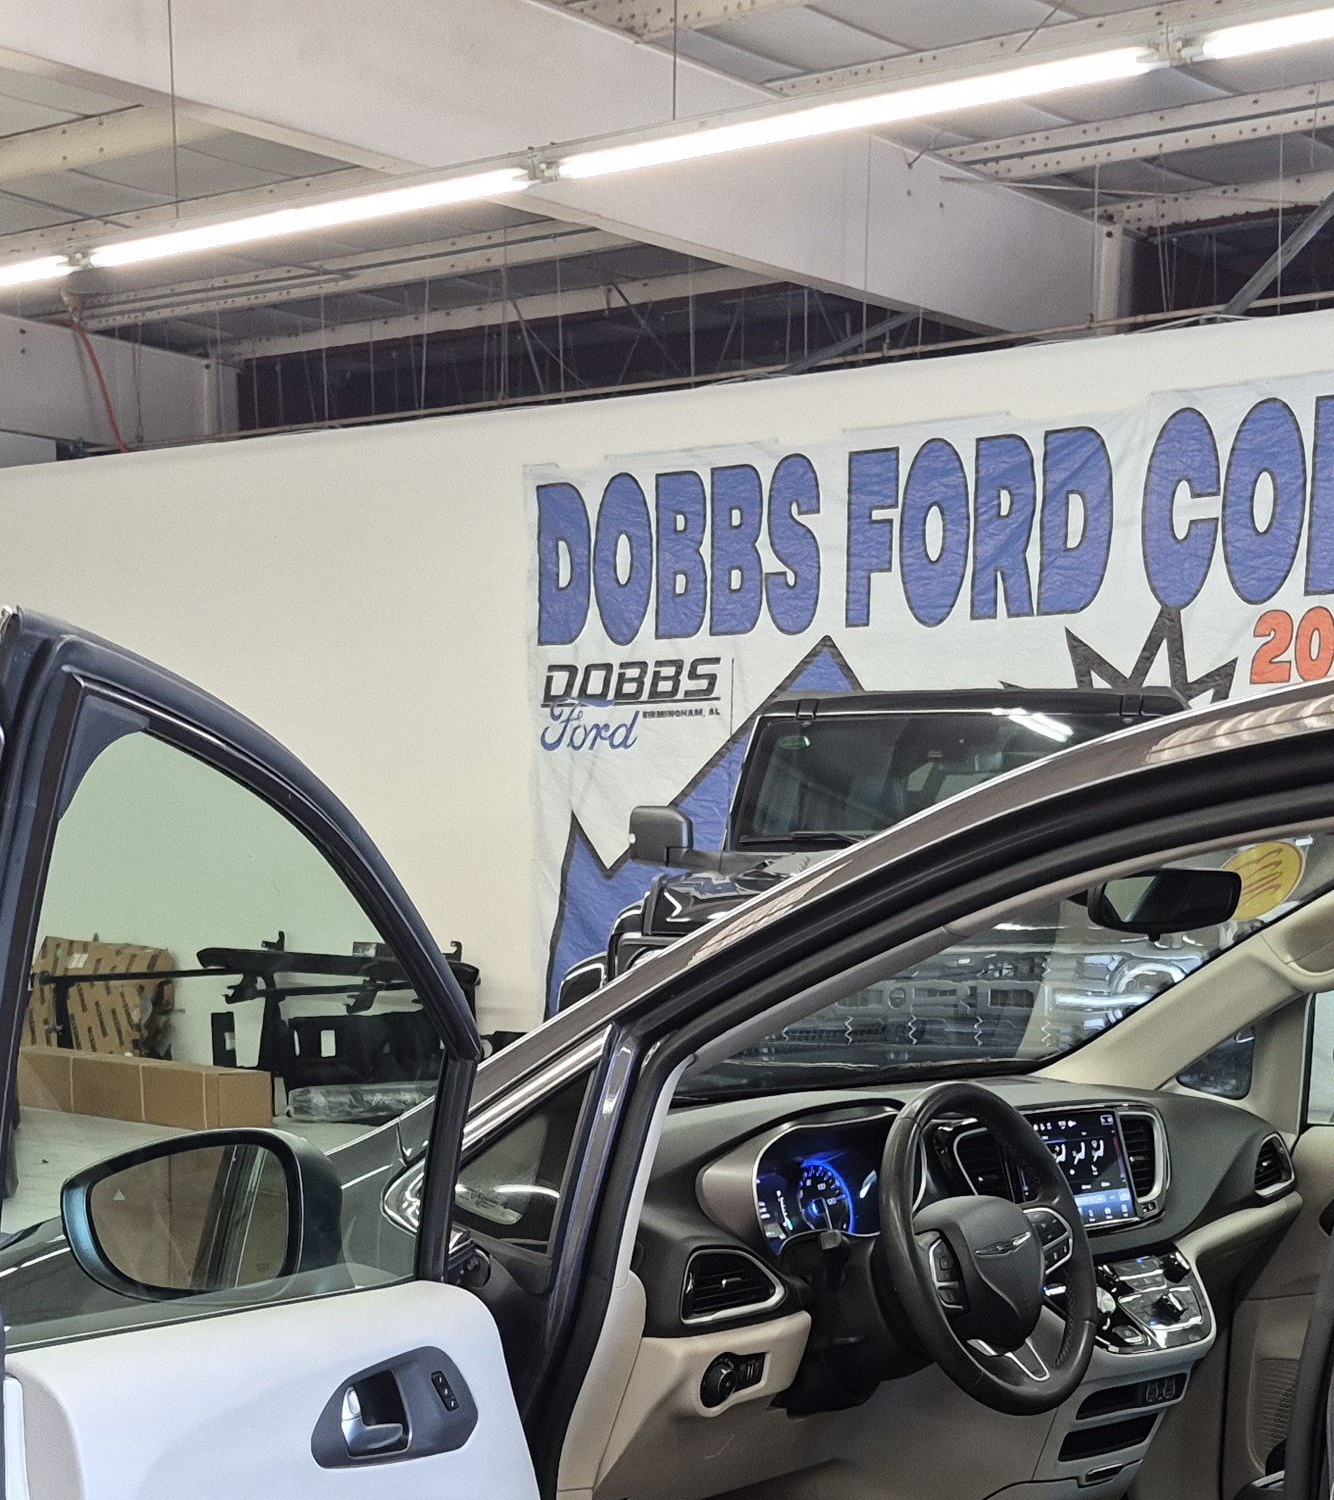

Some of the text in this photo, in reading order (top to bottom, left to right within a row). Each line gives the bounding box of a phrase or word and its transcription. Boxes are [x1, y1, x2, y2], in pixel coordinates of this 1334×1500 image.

[537, 453, 820, 647] DOBBS
[845, 425, 1114, 628] FORD
[543, 657, 722, 703] DOBBS
[540, 697, 641, 751] Ford
[642, 707, 721, 720] BIRMINGHAM, AL
